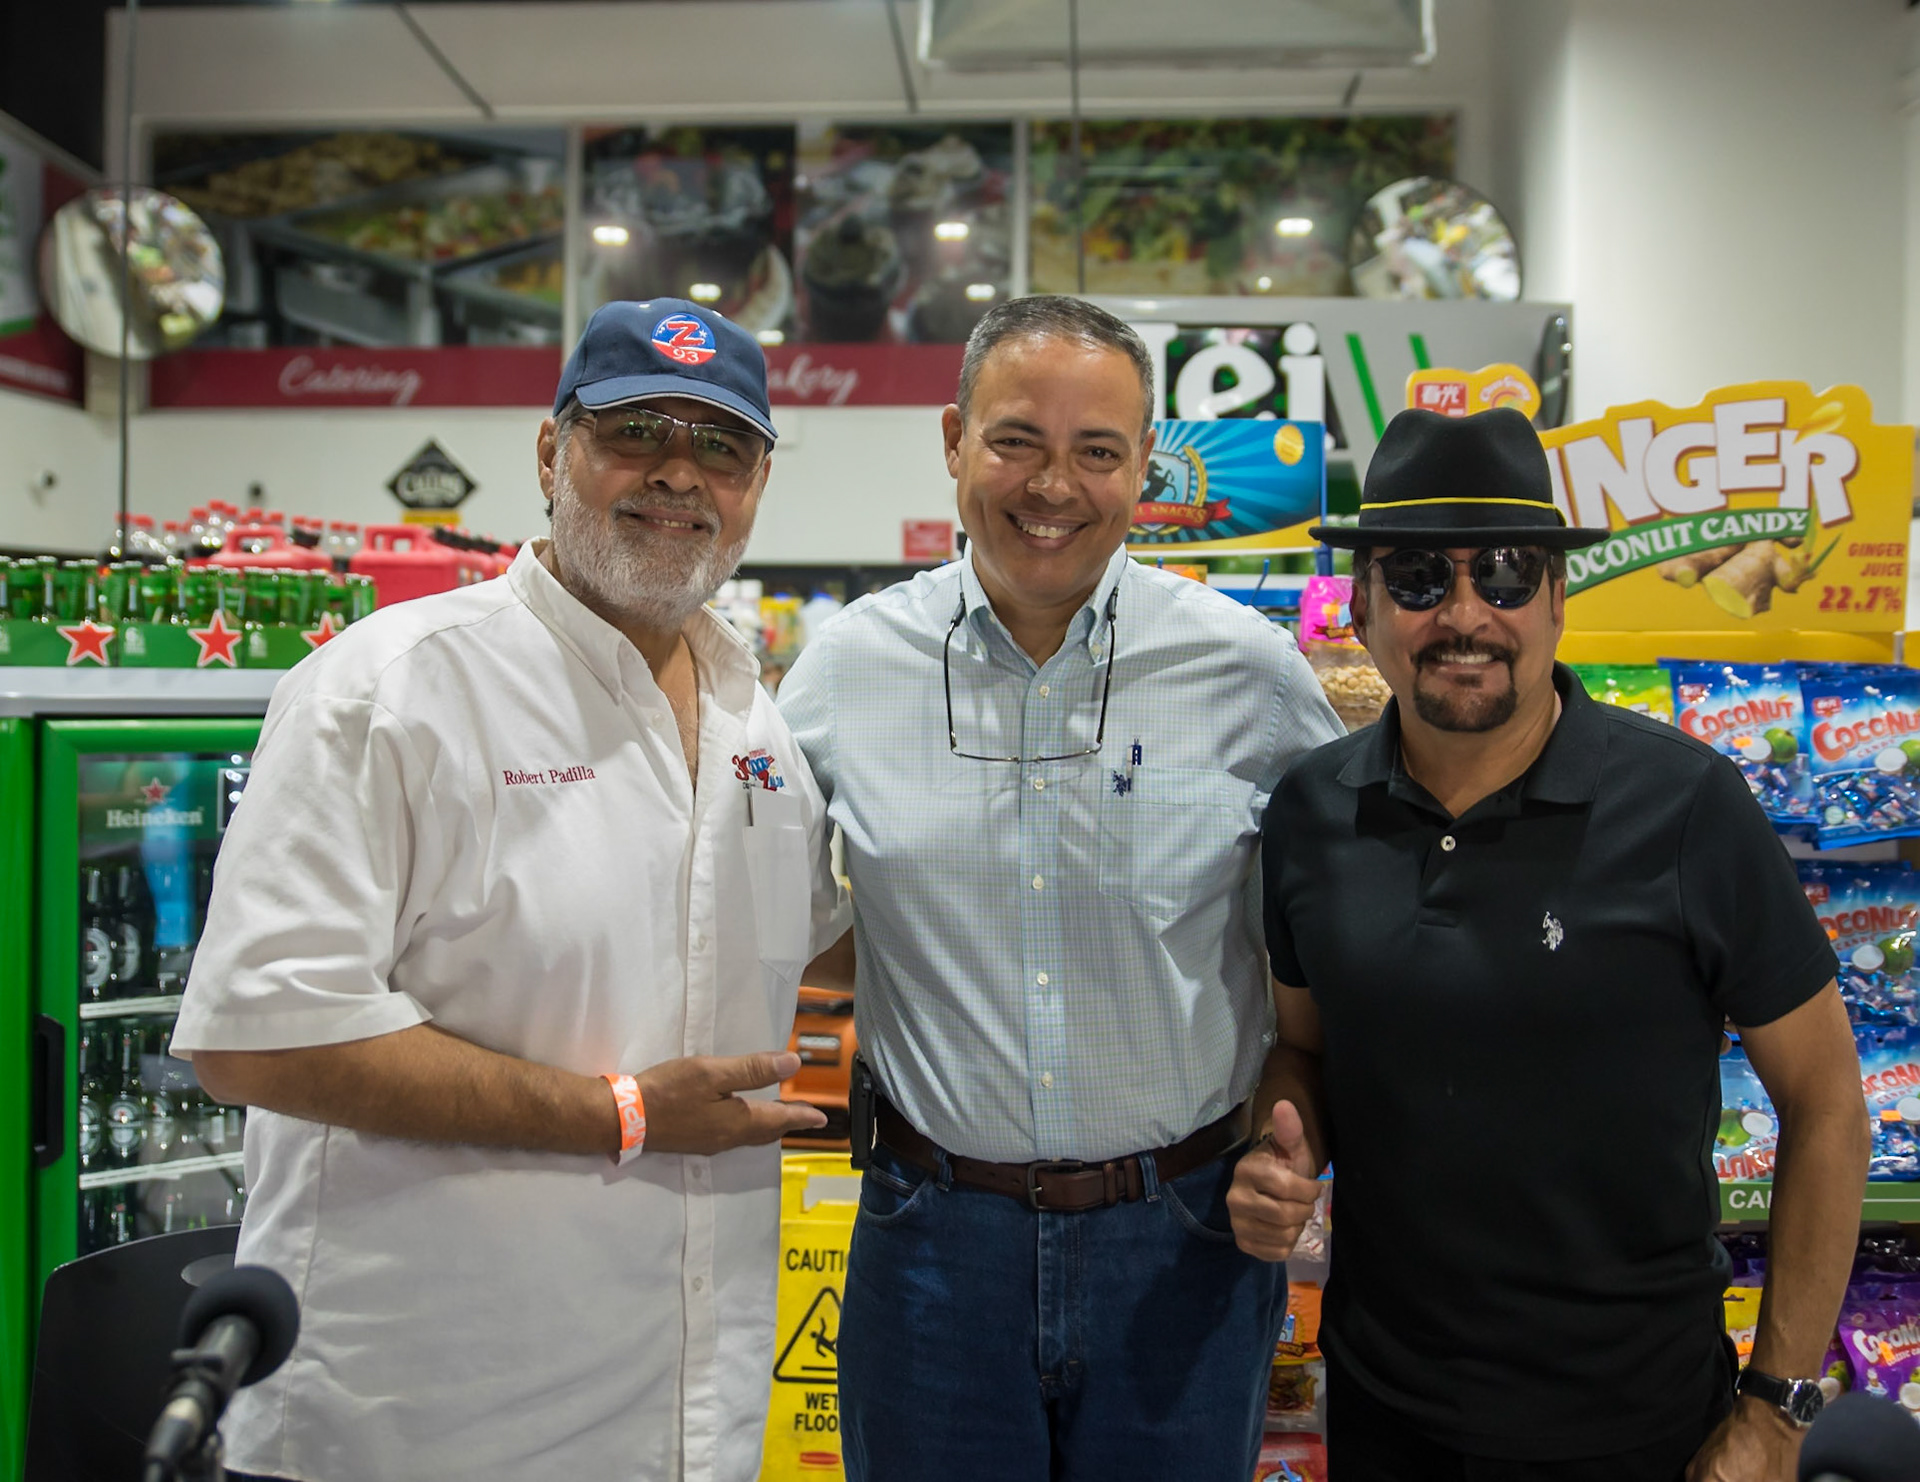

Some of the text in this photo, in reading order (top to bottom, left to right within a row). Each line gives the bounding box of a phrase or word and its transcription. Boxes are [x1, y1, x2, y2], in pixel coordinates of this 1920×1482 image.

[666, 320, 706, 347] Z
[673, 348, 699, 363] 93
[279, 355, 420, 408] Catering
[767, 353, 859, 407] akery
[1545, 398, 1858, 528] INGER
[1567, 511, 1809, 583] OCONUT CANDY
[1848, 543, 1905, 557] GINGER
[1860, 563, 1904, 577] JUICE
[1818, 586, 1903, 613] 22.7%
[1680, 699, 1794, 746] COCONUT
[1812, 710, 1920, 763] COCONU
[503, 765, 595, 785] Robert Padilla
[106, 808, 203, 829] Heineken
[1818, 906, 1917, 935] OCONUT
[786, 1248, 848, 1272] CAUTI
[805, 1392, 838, 1411] WET
[795, 1413, 839, 1432] FLOO
